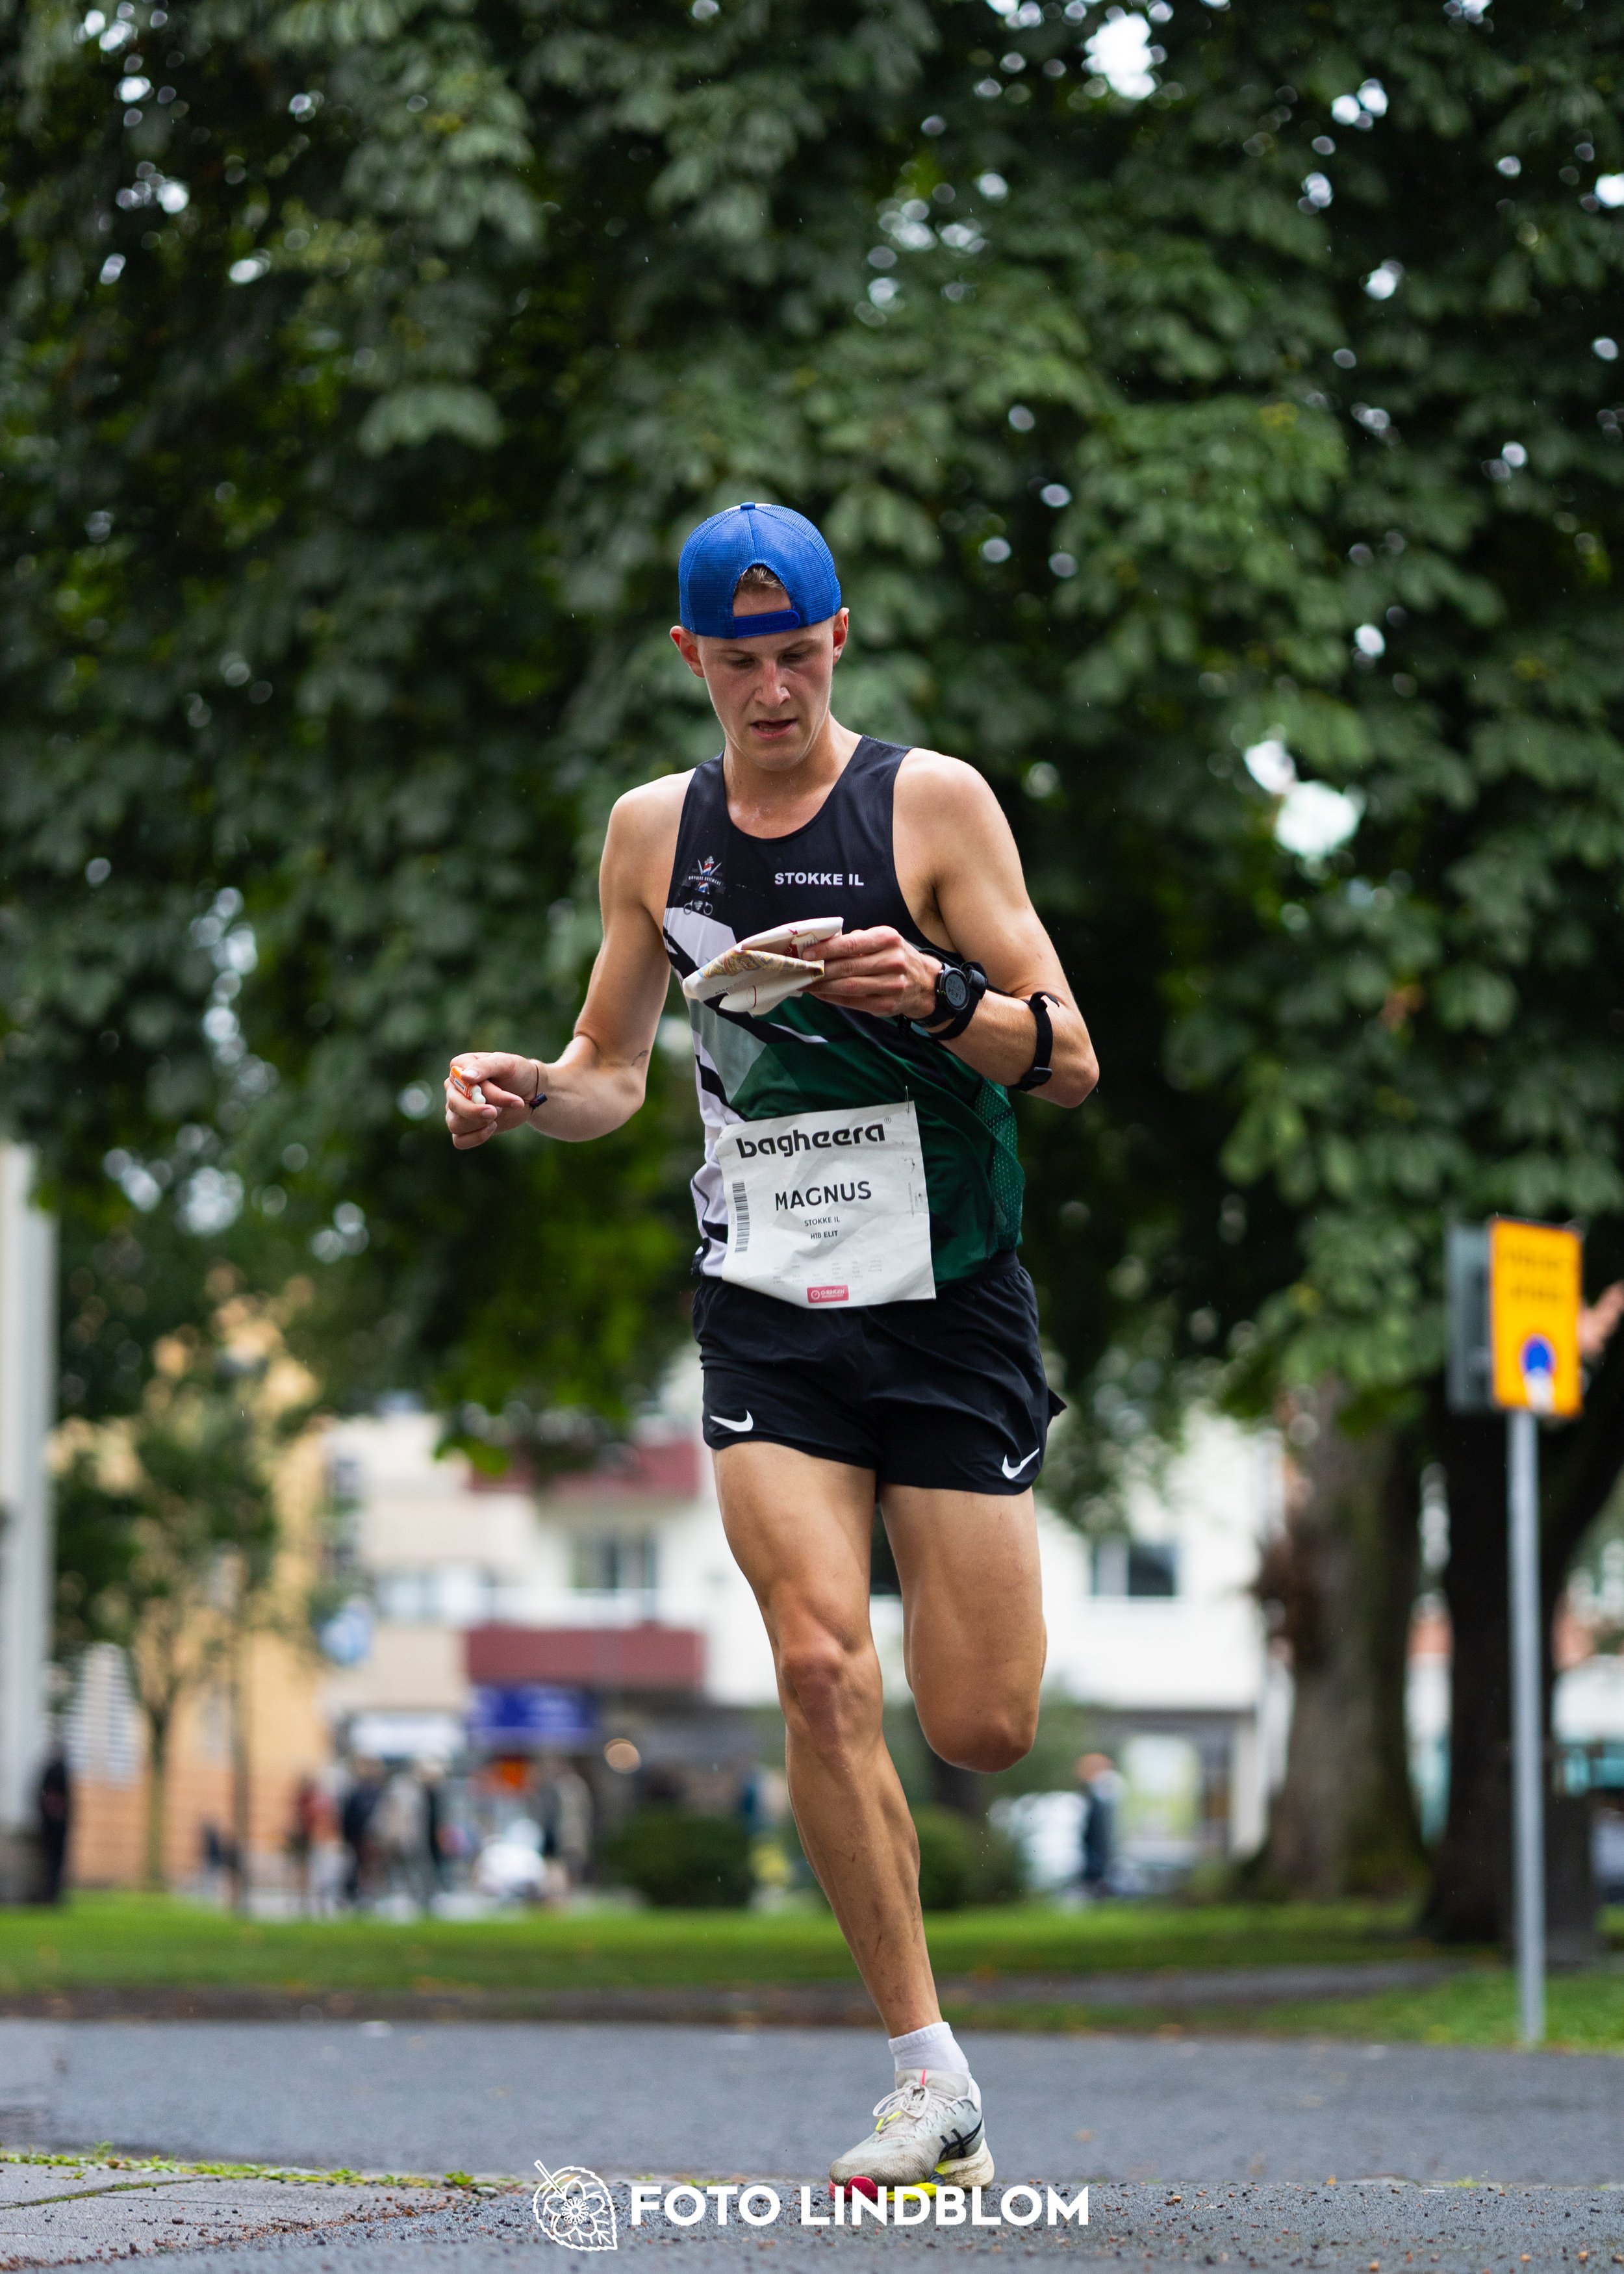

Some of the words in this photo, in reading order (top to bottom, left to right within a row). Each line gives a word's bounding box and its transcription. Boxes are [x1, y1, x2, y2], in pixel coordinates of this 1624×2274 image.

[774, 872, 843, 886] STOKKE
[848, 873, 865, 886] IL
[735, 1123, 885, 1158] bagheera
[774, 1181, 872, 1211] MAGNUS
[804, 1216, 832, 1227] STOKKE
